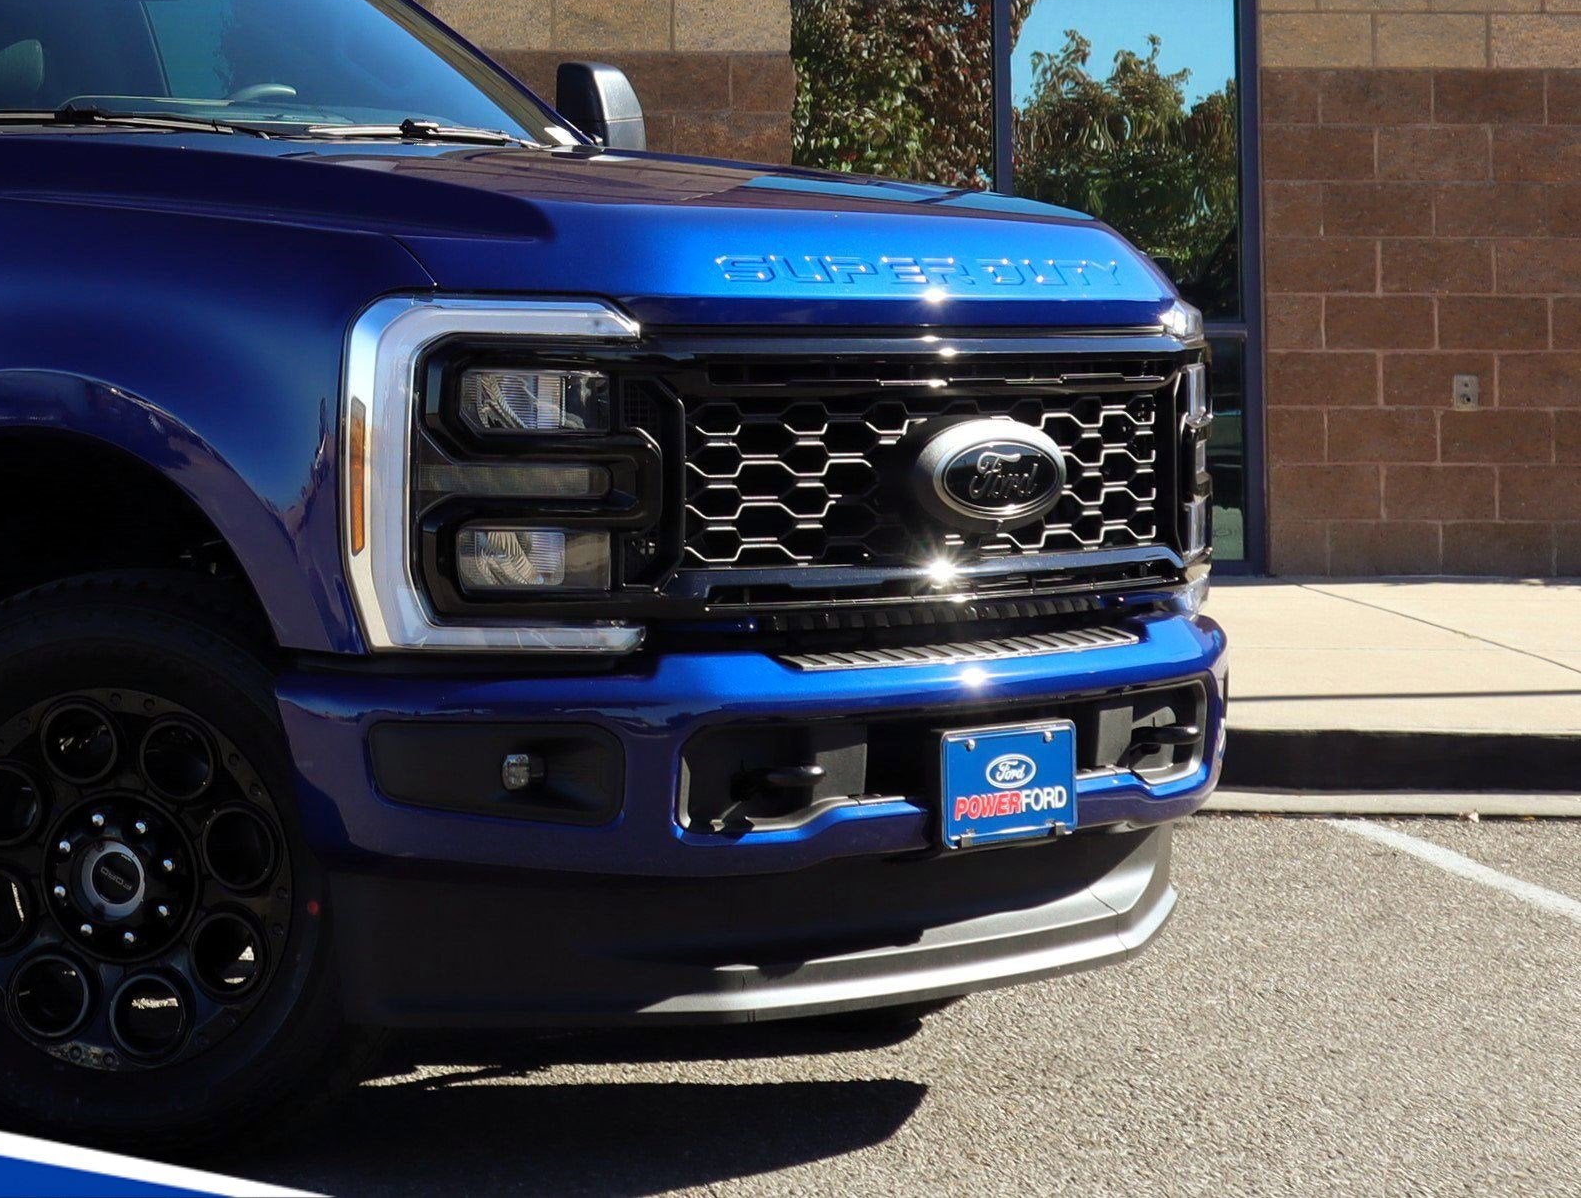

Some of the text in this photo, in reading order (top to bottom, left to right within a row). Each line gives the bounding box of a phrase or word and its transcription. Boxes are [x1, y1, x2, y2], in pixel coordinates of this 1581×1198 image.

[716, 255, 1123, 287] SUPER DUTY
[969, 451, 1039, 500] Ford
[995, 760, 1026, 782] Ford
